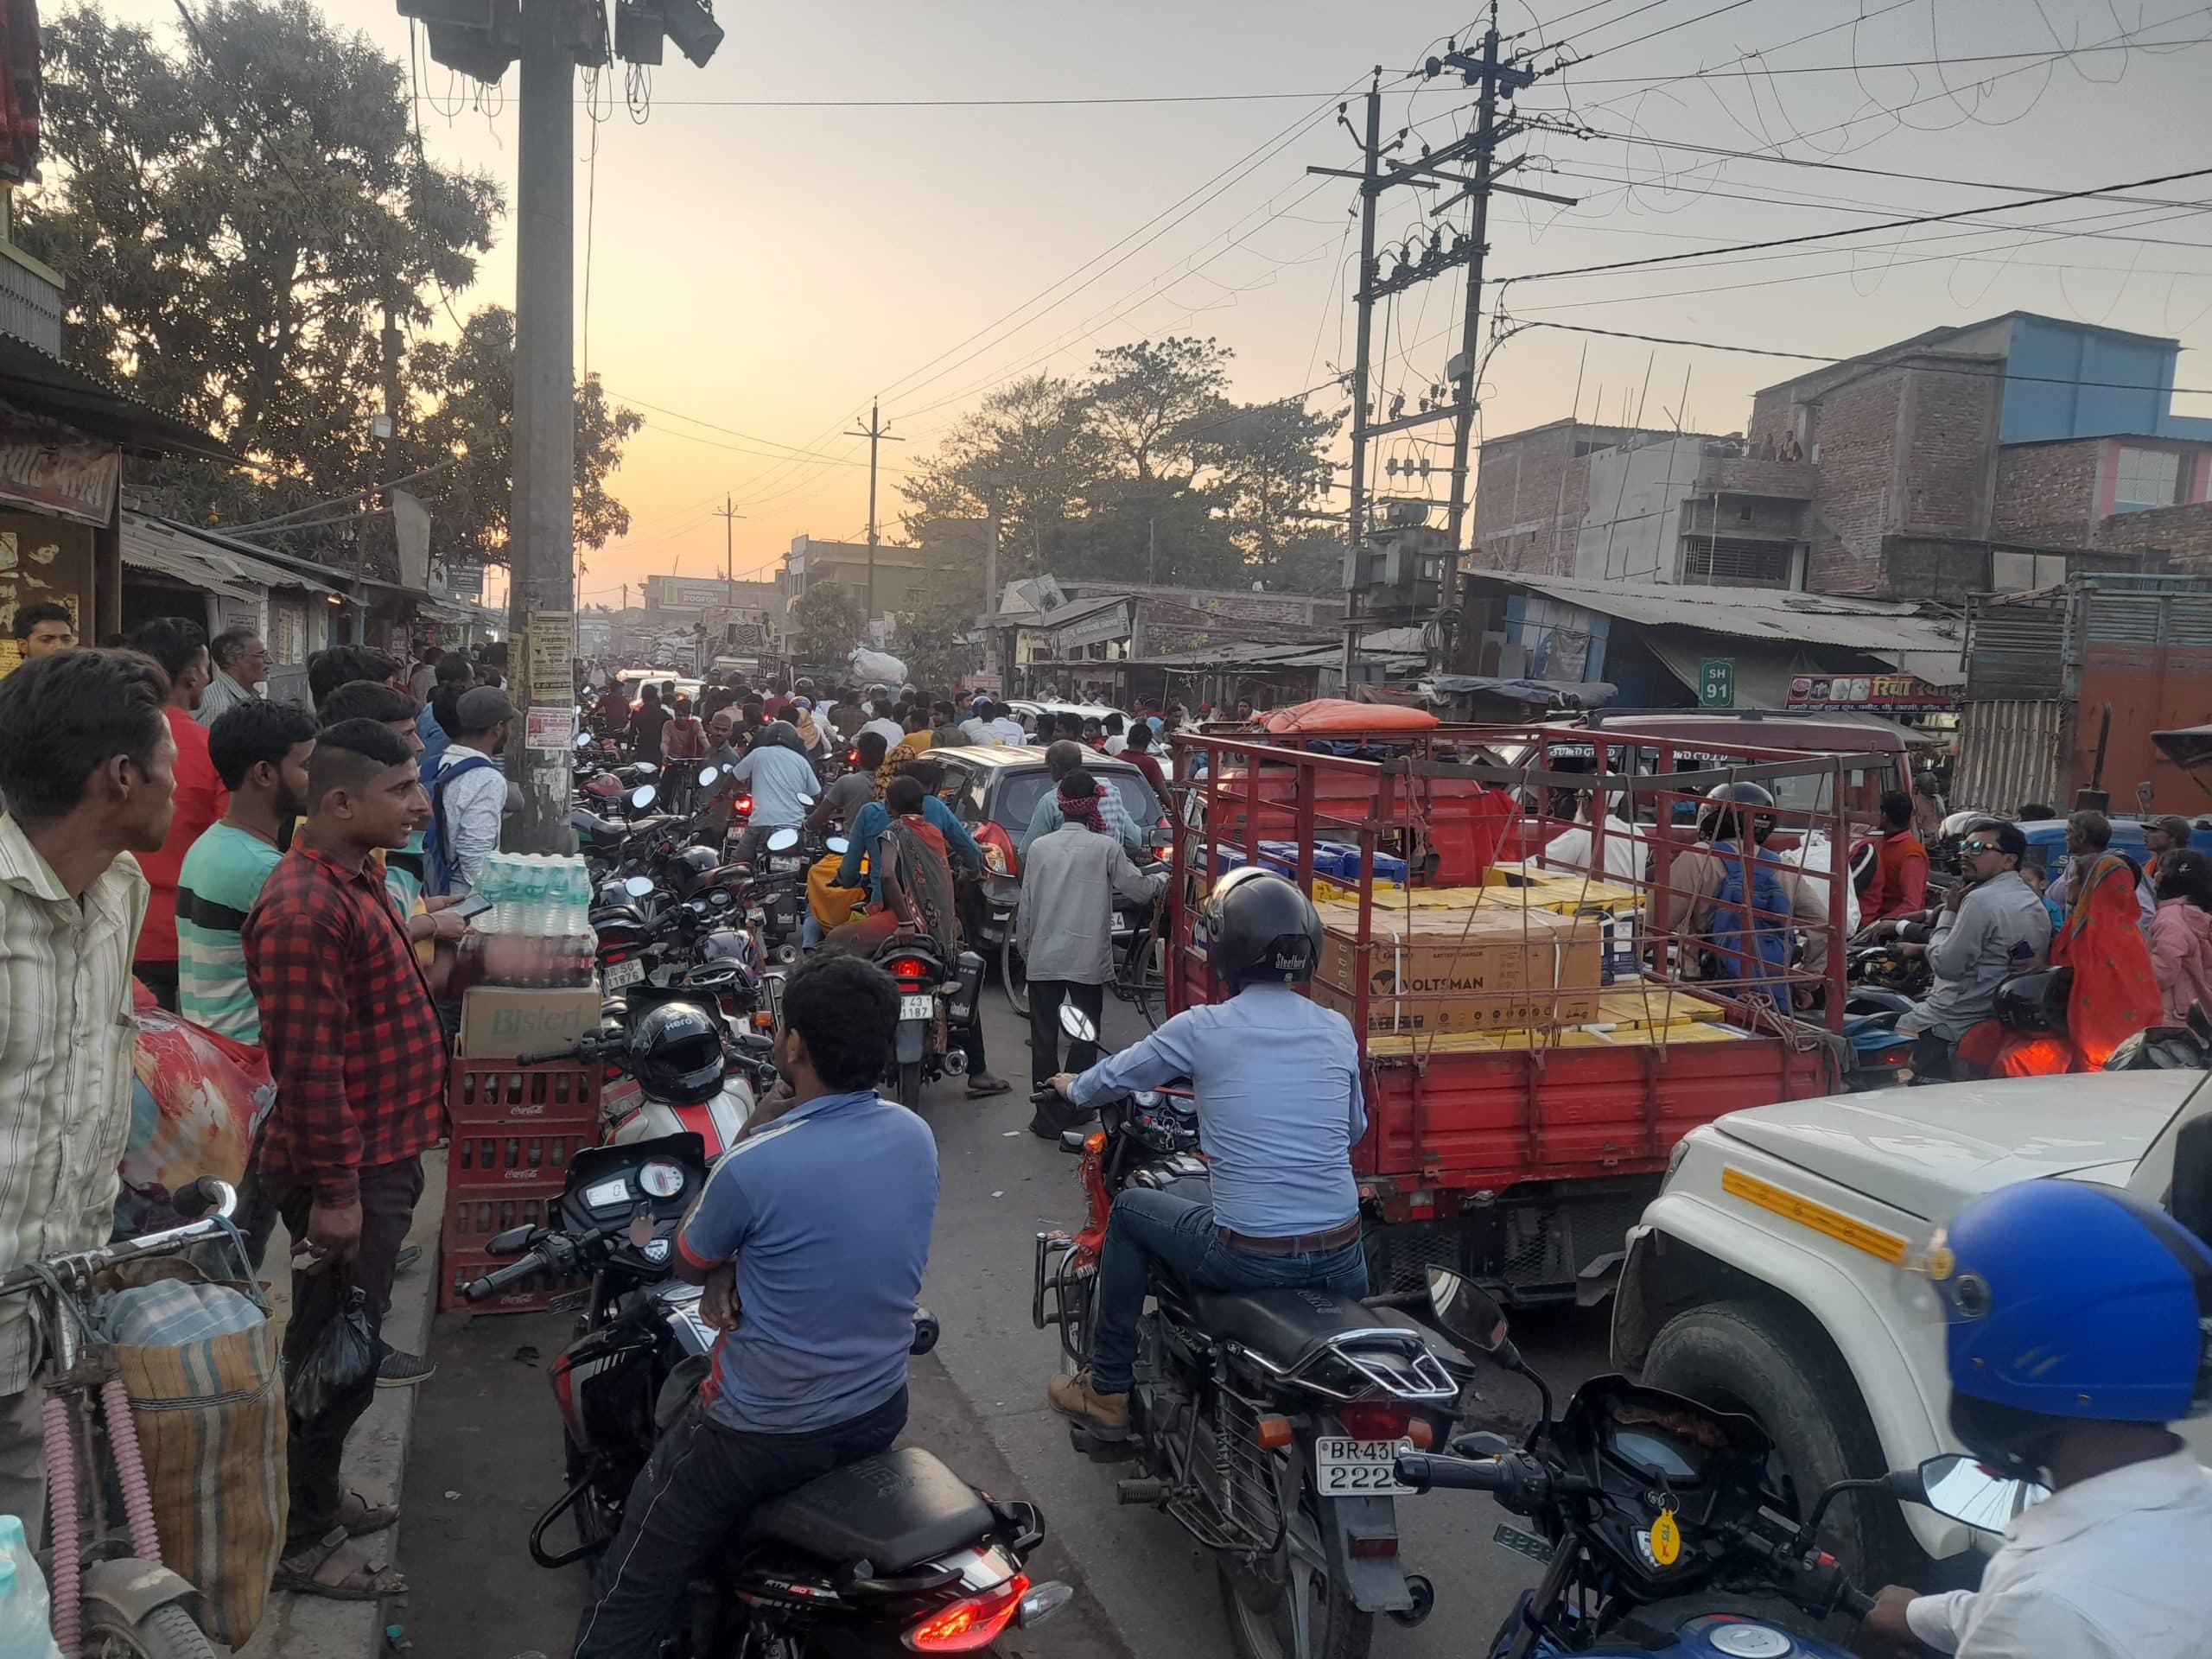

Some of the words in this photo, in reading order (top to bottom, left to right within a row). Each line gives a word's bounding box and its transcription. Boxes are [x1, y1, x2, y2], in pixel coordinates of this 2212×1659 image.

[1709, 669, 1726, 678] SH
[1707, 683, 1726, 698] 91
[1275, 953, 1307, 969] Steelbird
[492, 1003, 582, 1036] Bisleri
[665, 1019, 692, 1031] Hero
[1331, 1467, 1404, 1488] 222
